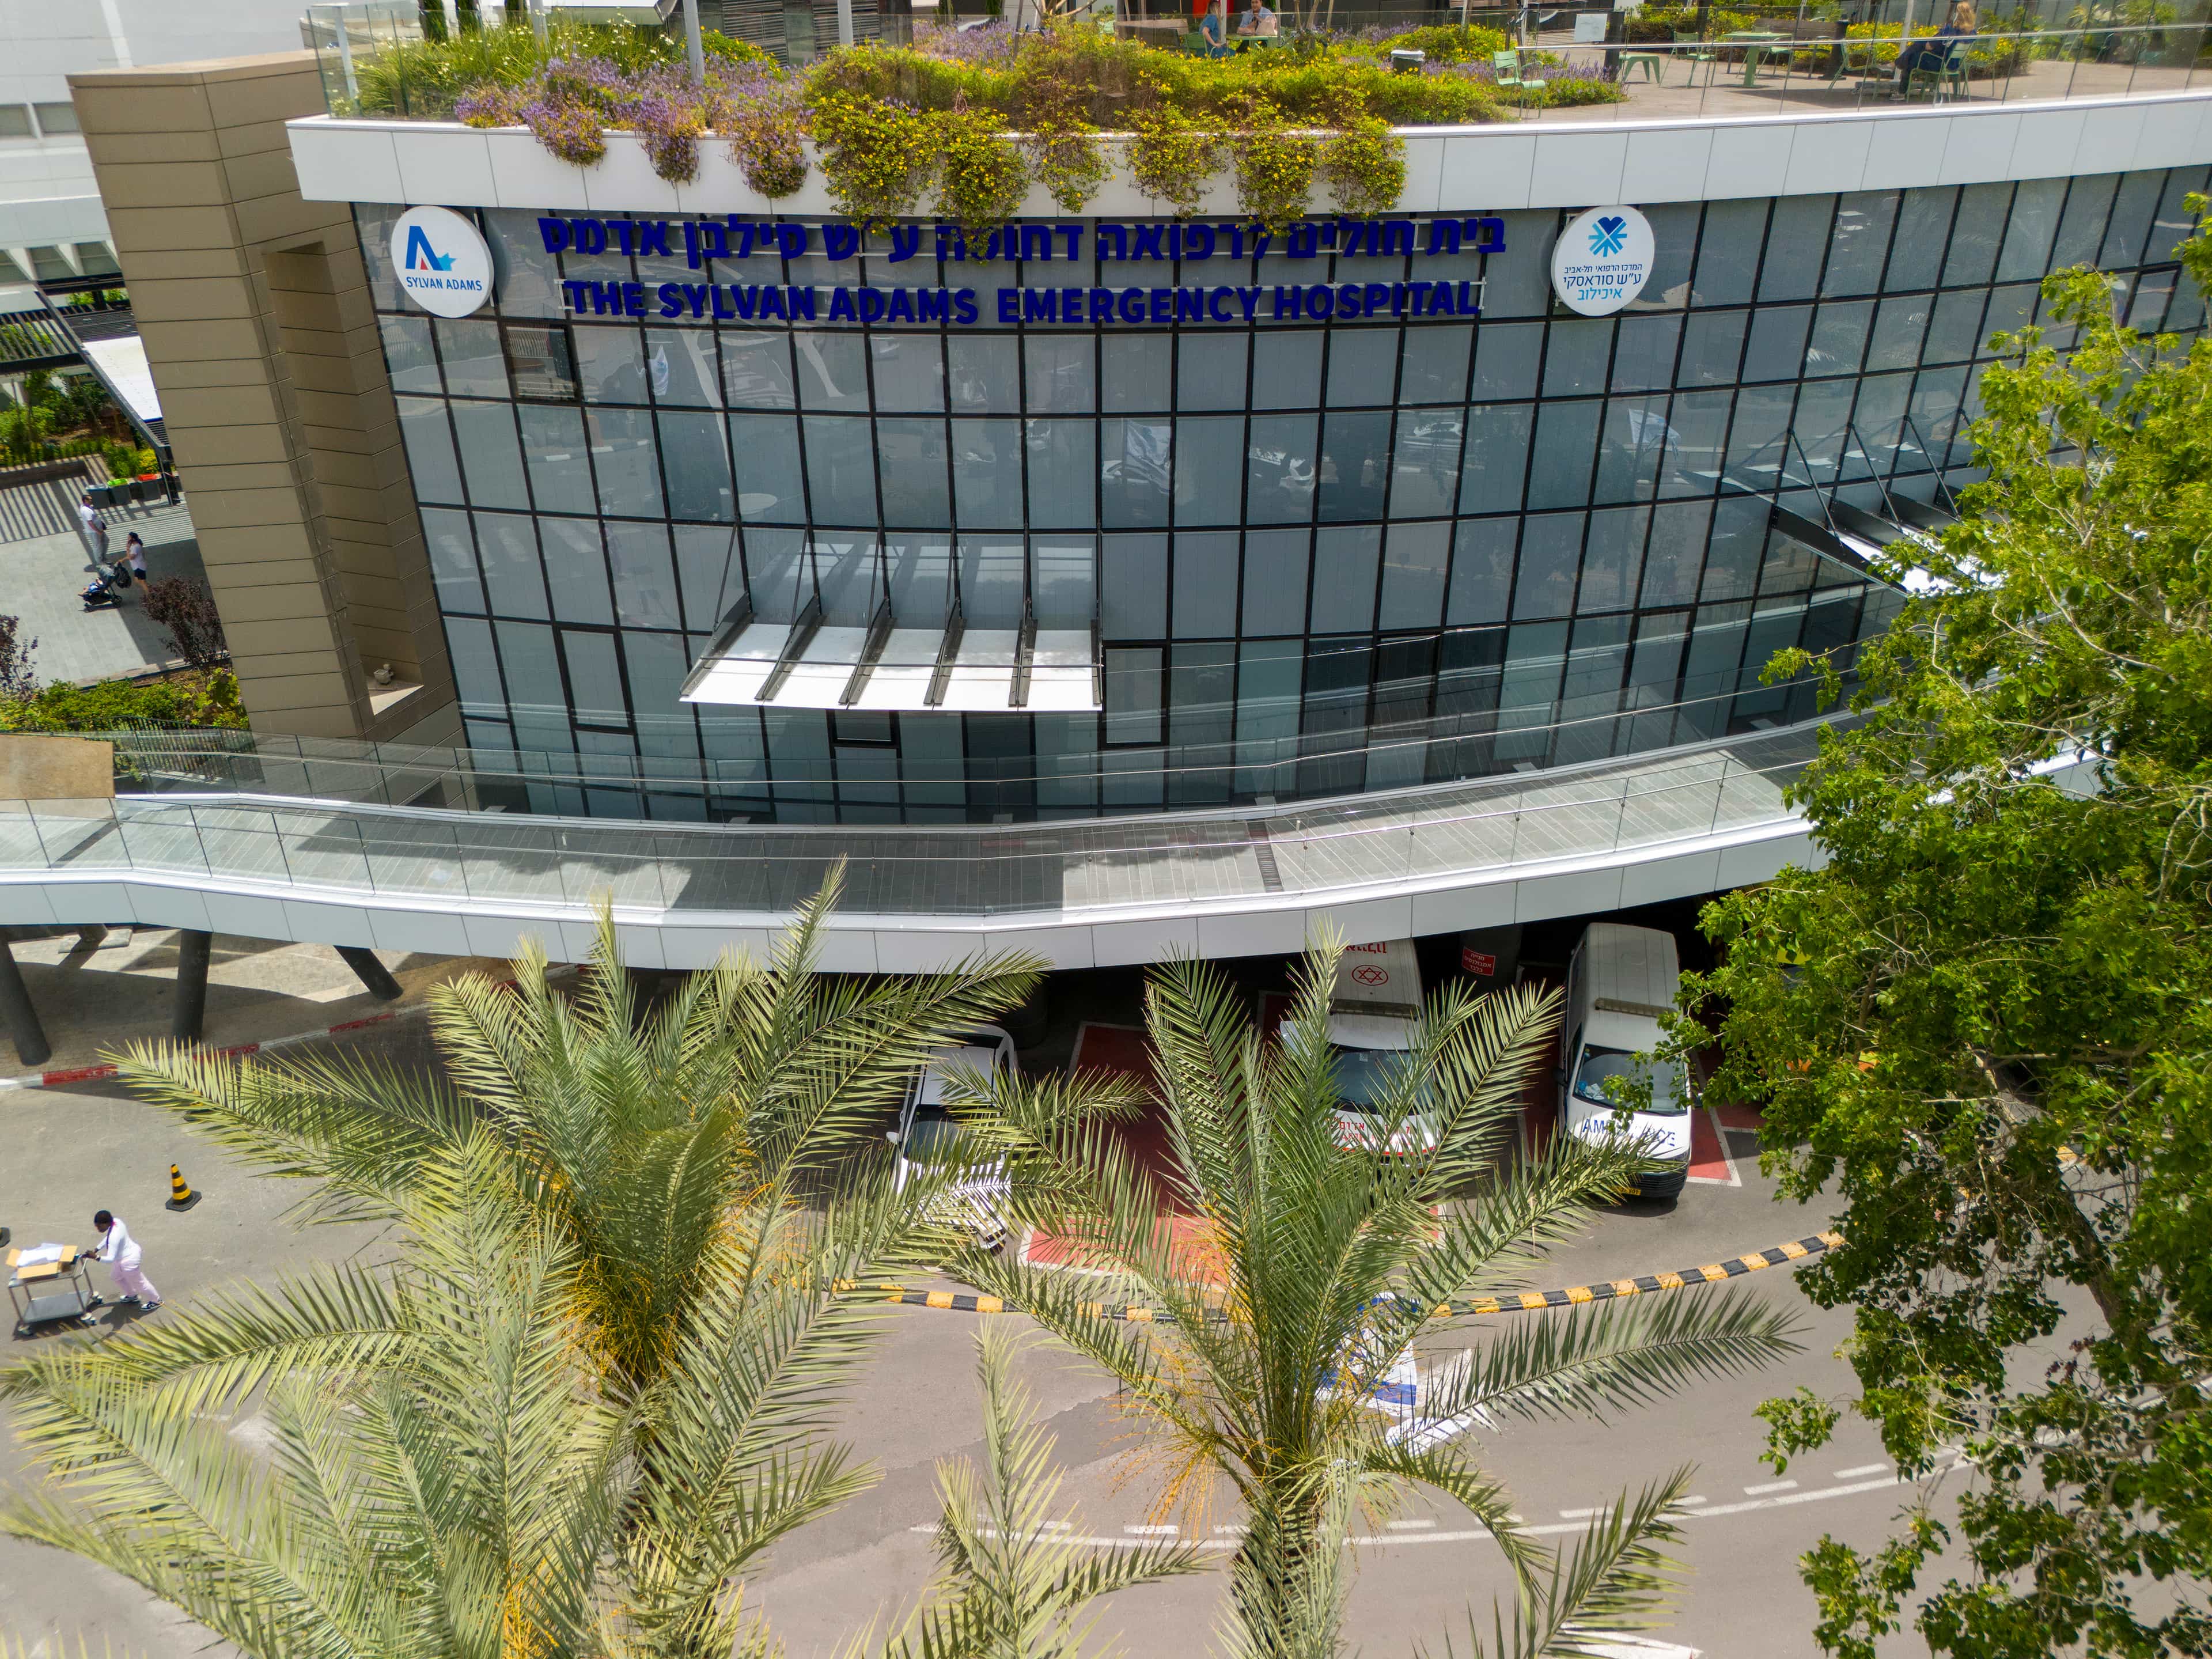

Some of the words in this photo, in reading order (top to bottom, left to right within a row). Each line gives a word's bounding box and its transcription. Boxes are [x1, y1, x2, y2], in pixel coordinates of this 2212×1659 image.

[537, 218, 673, 257] אדמס
[684, 214, 807, 270] סילבן
[822, 224, 919, 263] עש
[1096, 215, 1272, 260] לרפואה
[1287, 217, 1416, 259] חולים
[1426, 217, 1506, 256] בית
[1564, 265, 1593, 274] תל-אביב
[1595, 265, 1620, 273] הרפואי
[1621, 264, 1642, 272] המרכז
[406, 276, 444, 289] SYLVAN
[446, 278, 483, 291] ADAMS
[1563, 274, 1613, 290] סוראסקי
[1577, 287, 1623, 300] איכילוב
[561, 280, 649, 317] THE
[658, 282, 816, 321] SYLVAN
[828, 287, 979, 324] ADAMS
[998, 286, 1263, 323] EMERGENCY
[1274, 281, 1480, 321] HOSPITAL
[1470, 964, 1483, 973] בלבד
